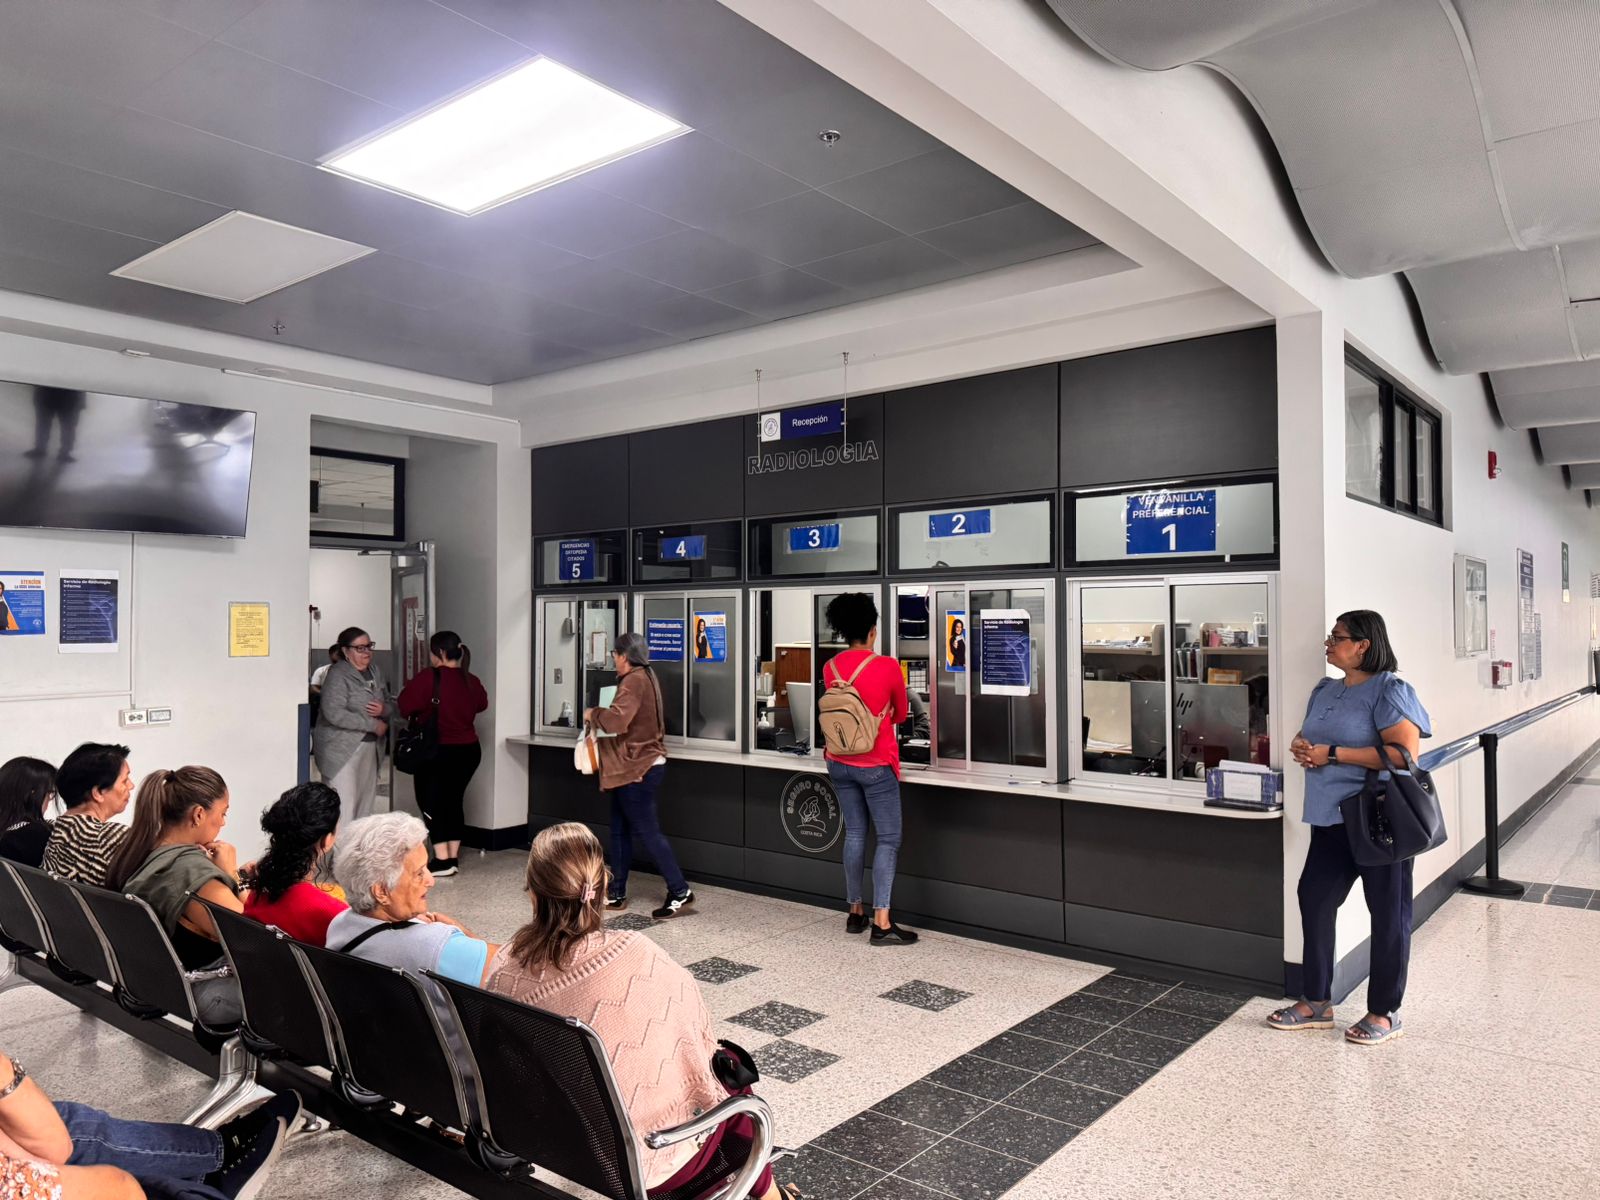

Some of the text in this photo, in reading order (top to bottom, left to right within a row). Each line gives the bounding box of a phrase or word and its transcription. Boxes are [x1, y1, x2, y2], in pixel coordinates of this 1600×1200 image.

[792, 415, 829, 428] Recepción
[747, 440, 879, 475] RADIOLOGIA
[951, 513, 966, 534] 2
[808, 529, 821, 548] 3
[1161, 523, 1177, 551] 1
[675, 540, 686, 557] 4
[572, 562, 581, 578] 5
[1176, 692, 1194, 715] hp
[786, 780, 837, 820] SEGURO SOCIAL
